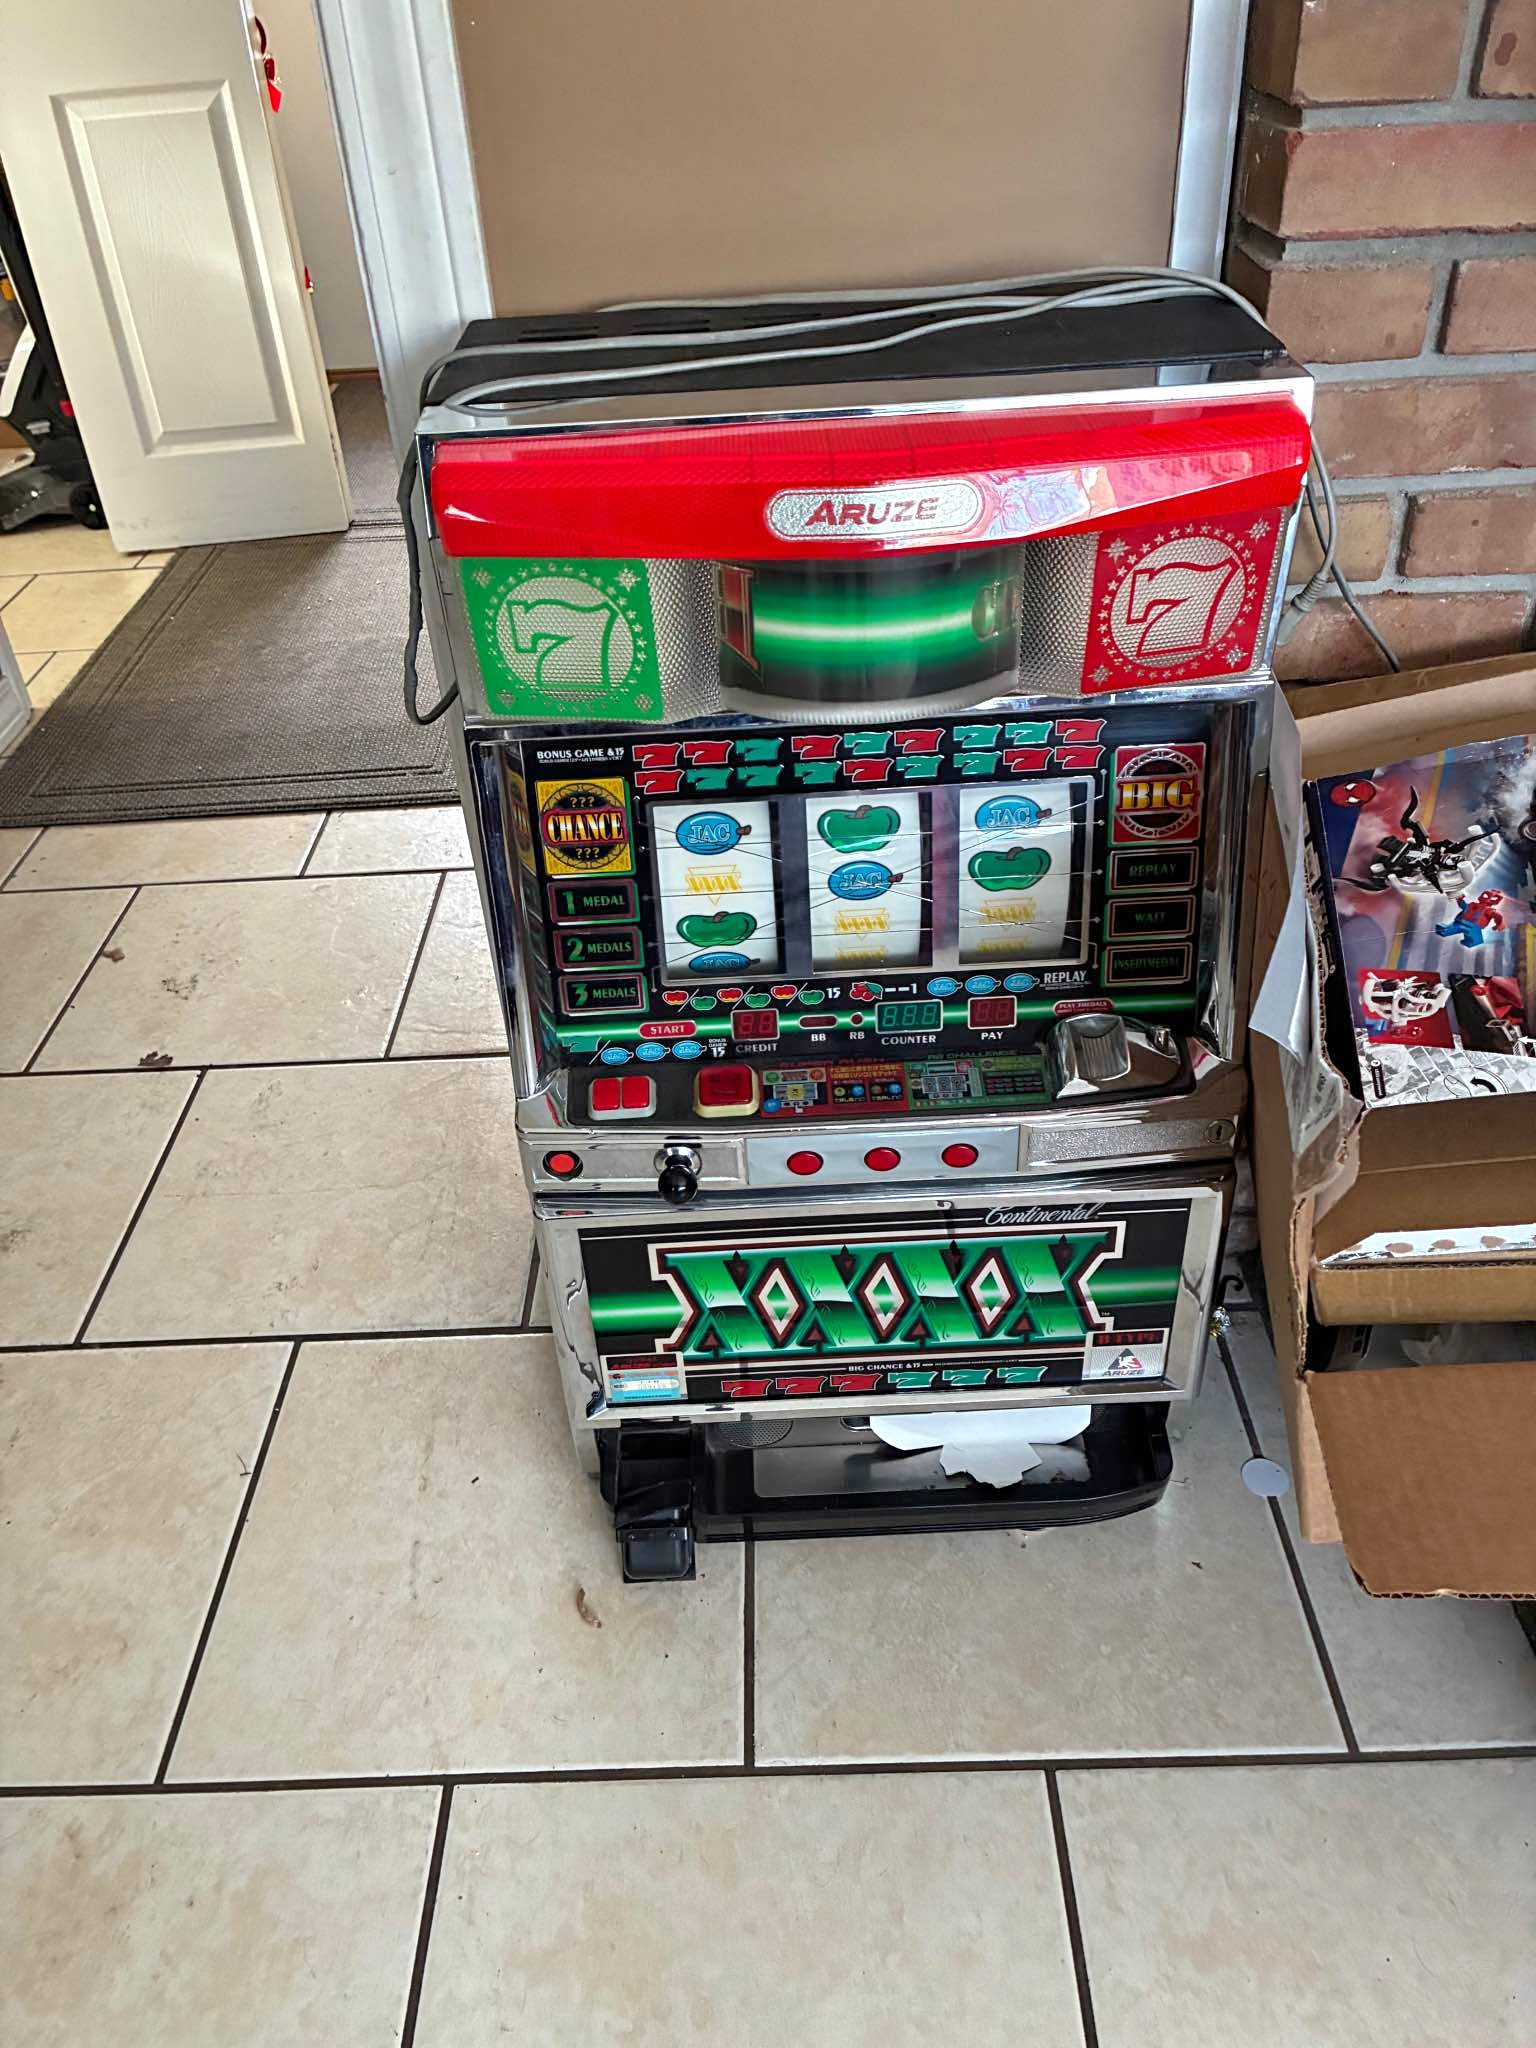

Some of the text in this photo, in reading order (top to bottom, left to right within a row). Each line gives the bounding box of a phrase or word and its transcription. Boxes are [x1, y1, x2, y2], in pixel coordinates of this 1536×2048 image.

[805, 497, 939, 526] ARUZE
[536, 750, 572, 760] BONUS
[575, 748, 604, 758] GAME
[1119, 778, 1195, 810] BIG
[987, 807, 1031, 827] JAC
[547, 813, 624, 842] CHANCE
[688, 823, 730, 844] JAC
[840, 871, 883, 891] JAC
[583, 895, 625, 907] MEDAL
[567, 937, 632, 961] 2 MEDALS
[1044, 970, 1087, 984] REPLAY
[572, 983, 637, 1007] 3 MEDALS
[826, 987, 841, 999] 15
[650, 1024, 686, 1036] START
[850, 1030, 865, 1041] RB
[981, 1031, 1003, 1041] PAY
[811, 1032, 826, 1043] BB
[881, 1034, 937, 1046] COUNTER
[711, 1047, 726, 1058] 15
[735, 1043, 777, 1054] CREDIT
[985, 1203, 1103, 1226] Continental
[867, 1363, 904, 1371] CHANCE
[1102, 1369, 1145, 1377] ARUZE
